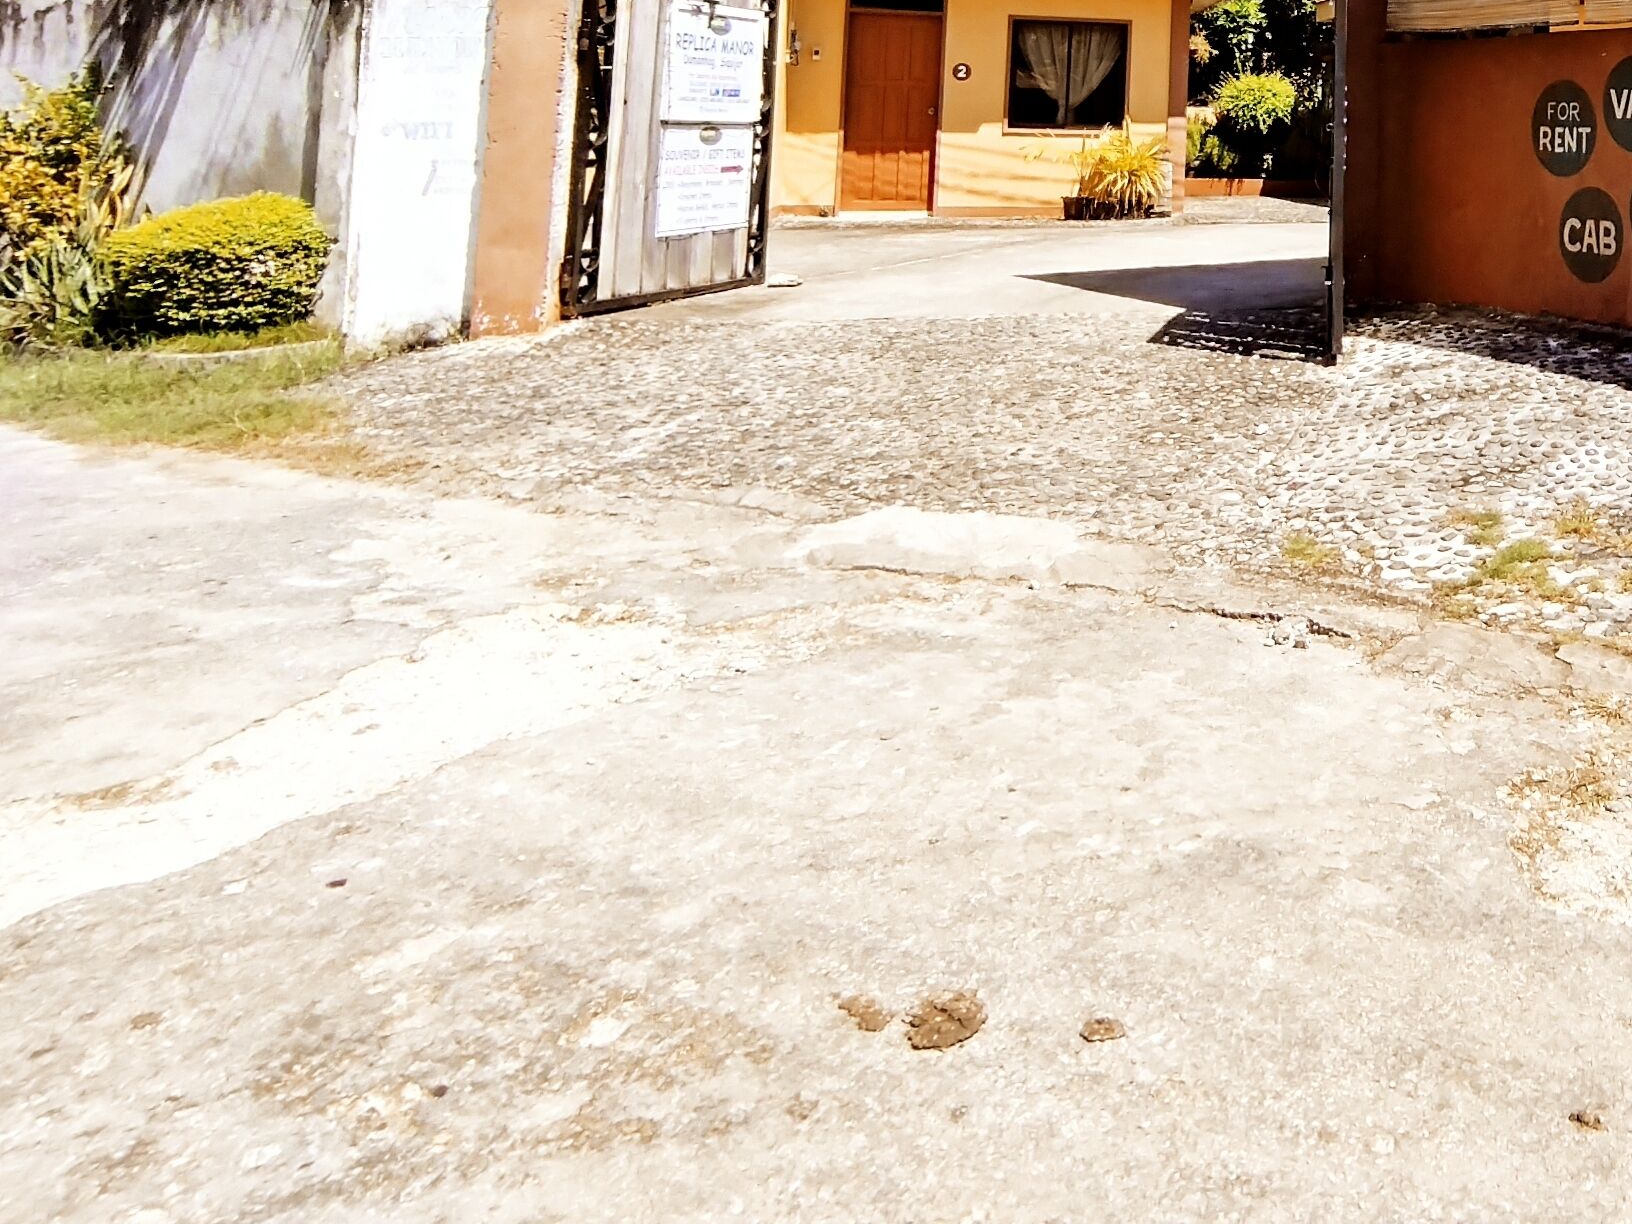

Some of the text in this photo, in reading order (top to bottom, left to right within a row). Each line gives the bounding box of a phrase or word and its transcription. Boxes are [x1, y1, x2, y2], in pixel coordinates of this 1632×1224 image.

[676, 32, 754, 55] REPLICA MANOR
[957, 66, 967, 77] 2
[1547, 102, 1580, 122] FOR
[1539, 126, 1592, 154] RENT
[1563, 217, 1617, 256] CAB
